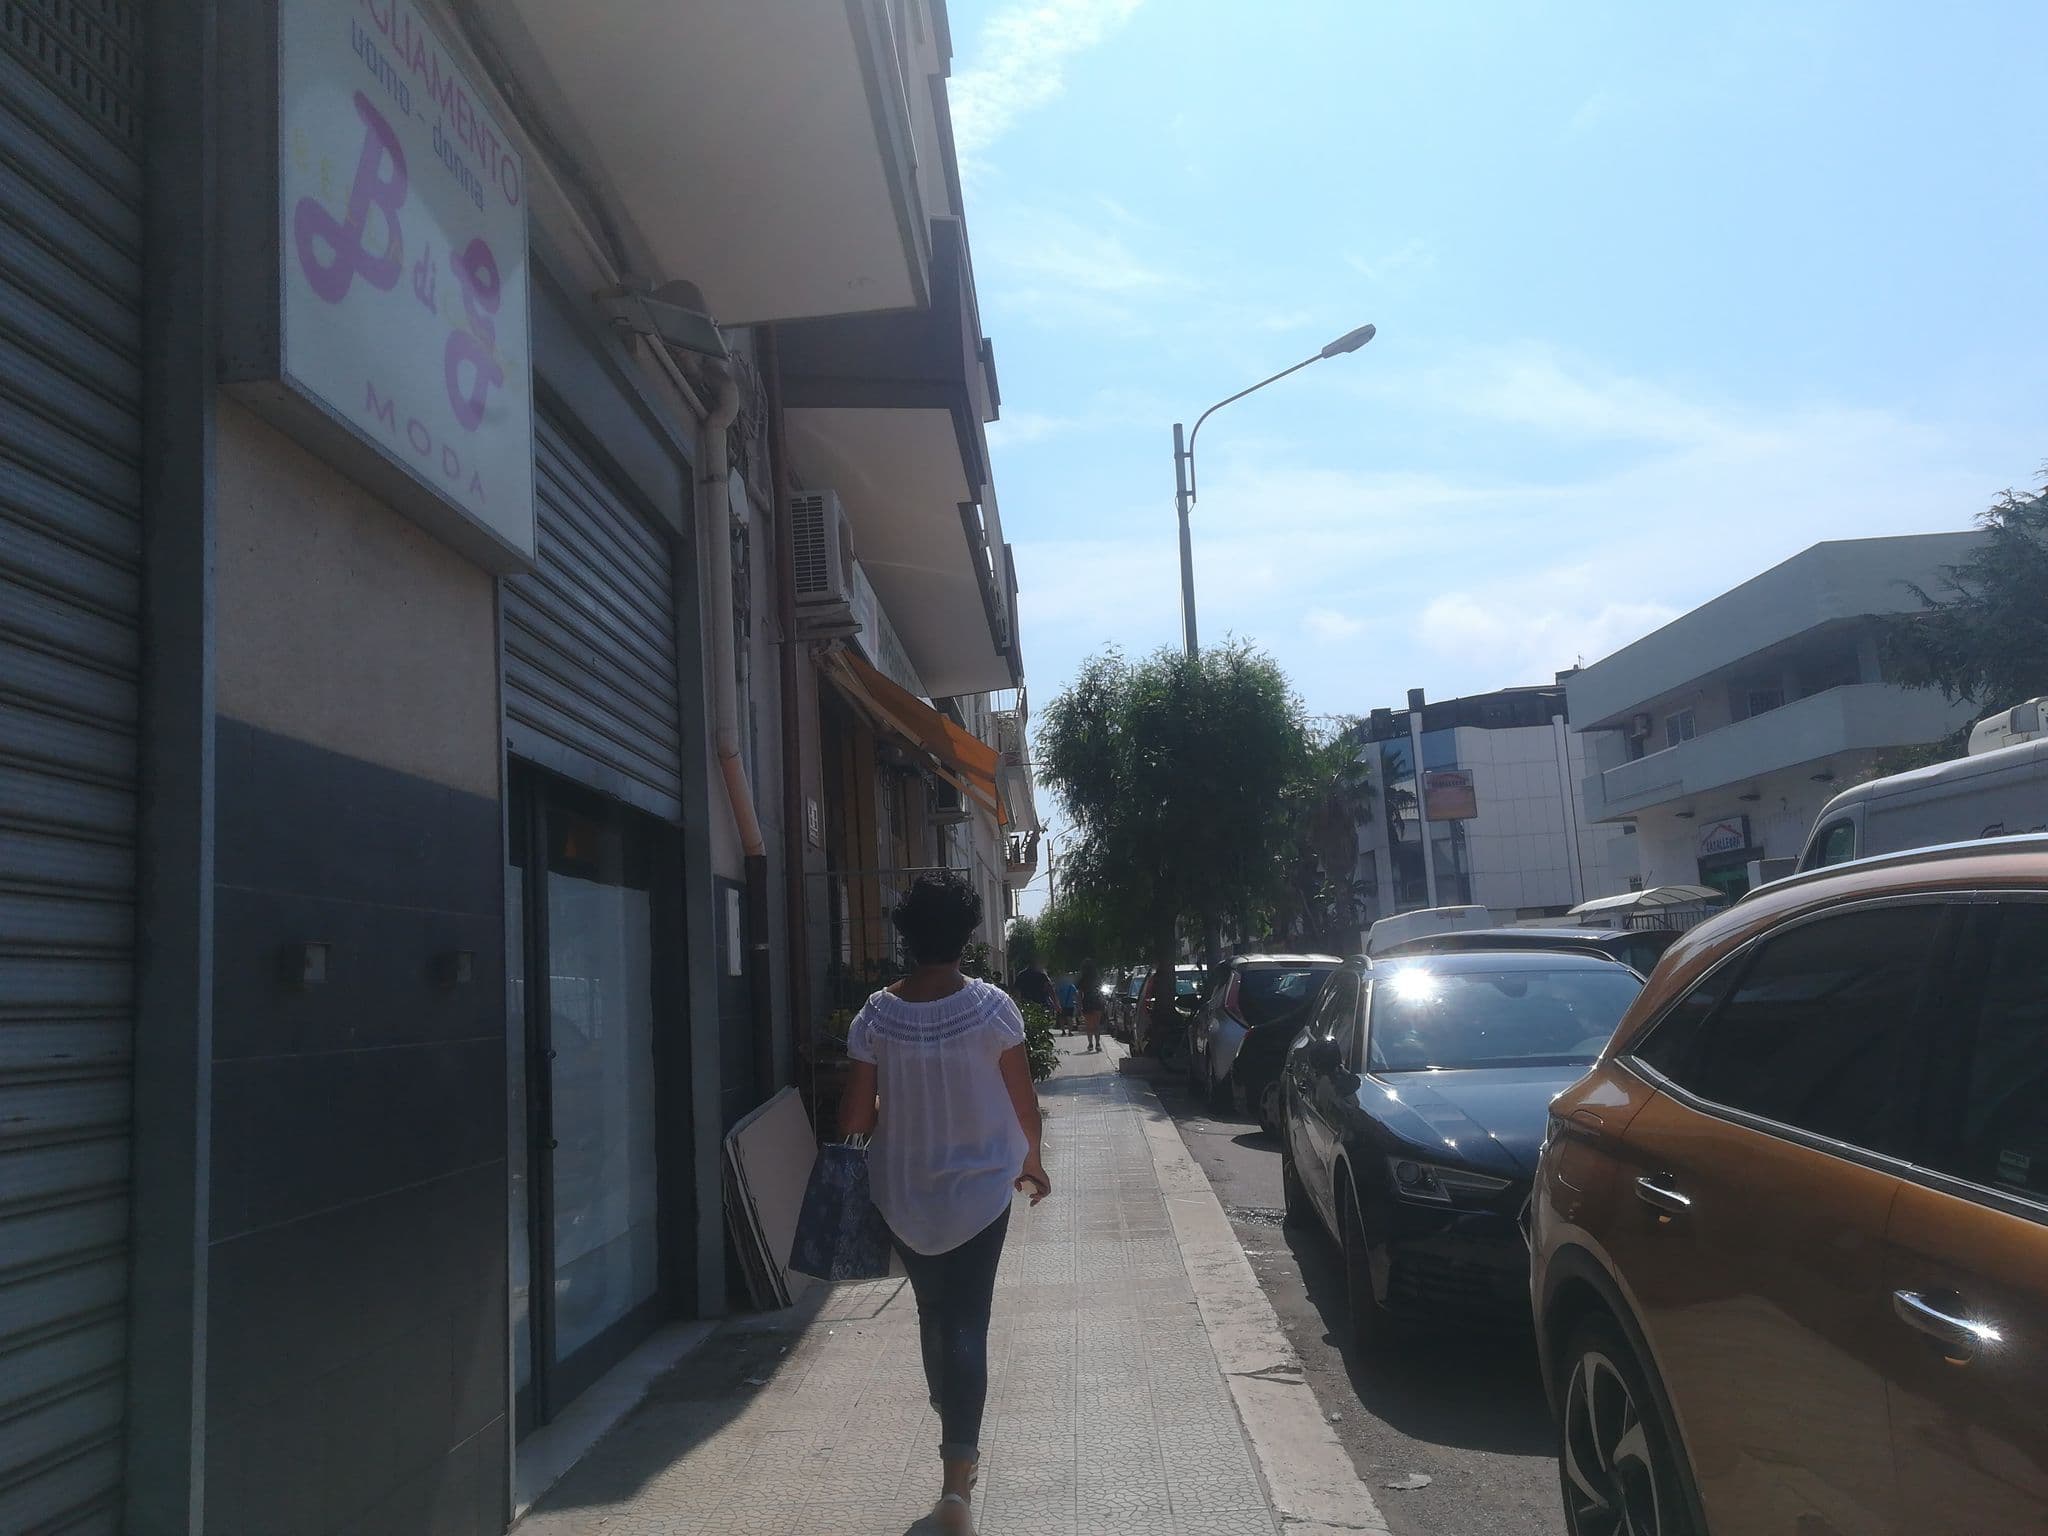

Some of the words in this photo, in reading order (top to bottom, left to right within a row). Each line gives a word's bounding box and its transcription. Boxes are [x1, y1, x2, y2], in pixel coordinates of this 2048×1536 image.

[294, 89, 407, 304] B
[414, 240, 437, 315] di
[352, 16, 410, 116] uomo
[432, 115, 484, 211] donna
[364, 380, 487, 505] MODA
